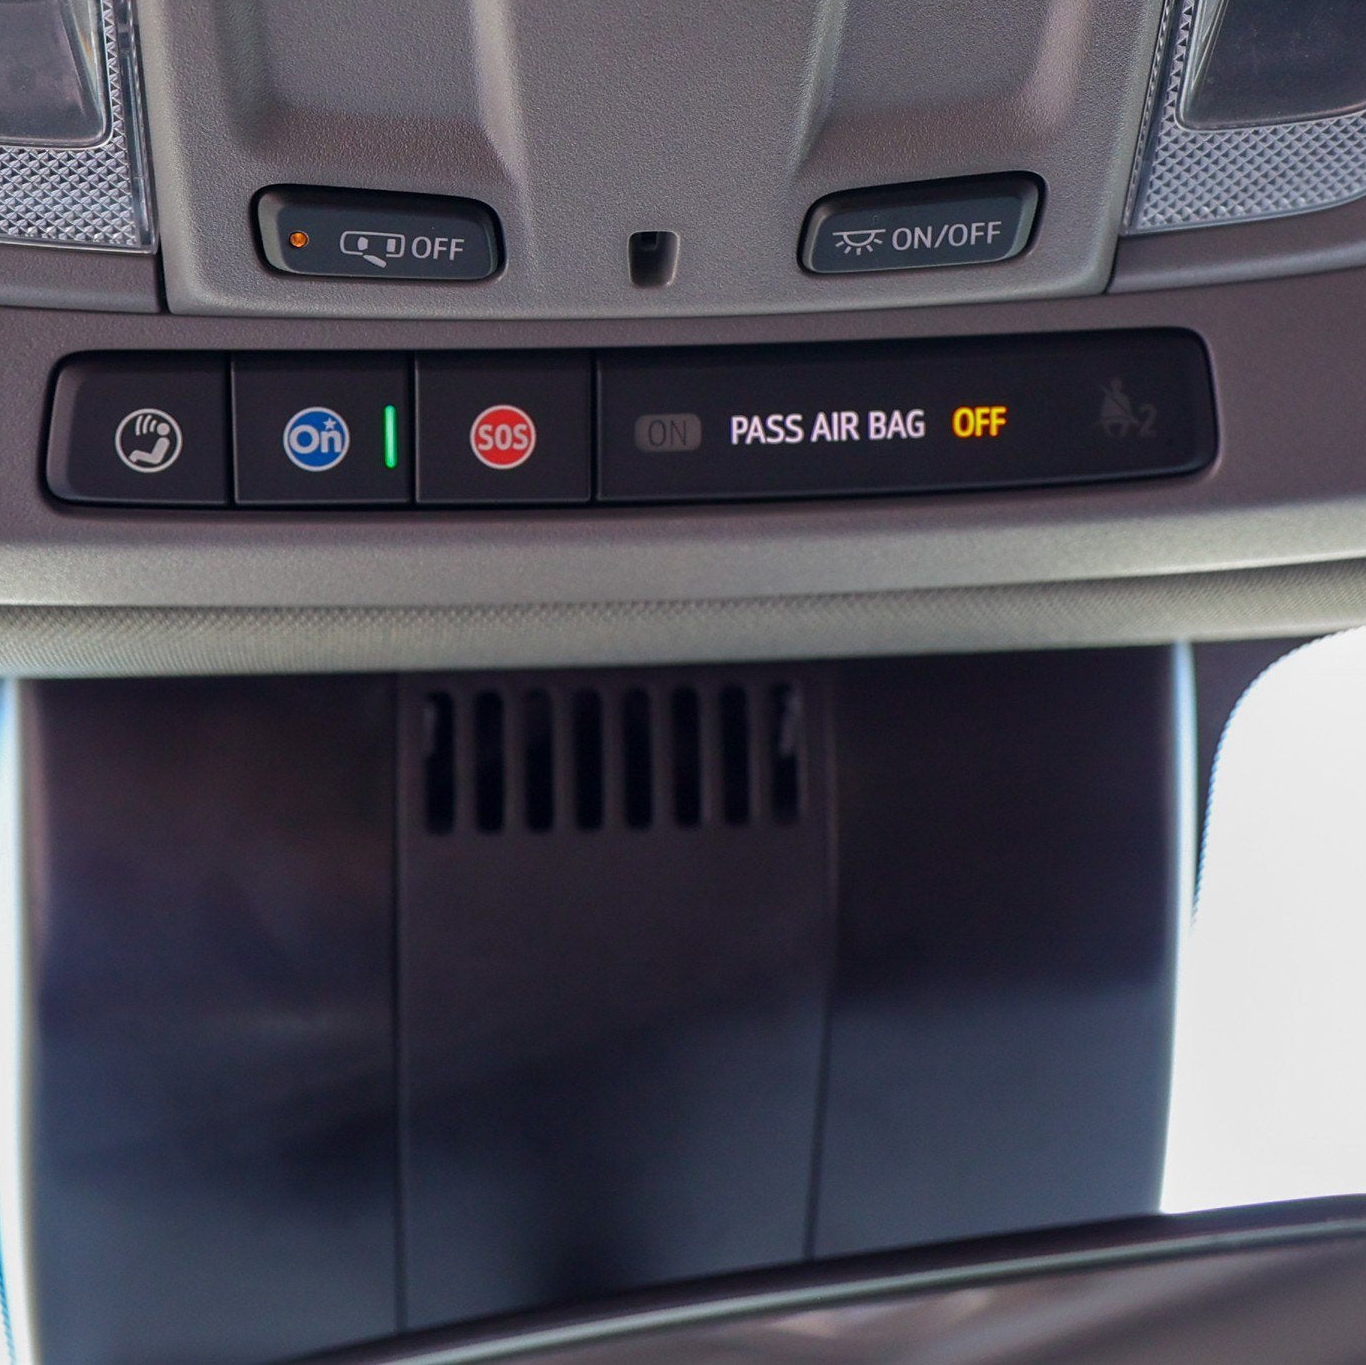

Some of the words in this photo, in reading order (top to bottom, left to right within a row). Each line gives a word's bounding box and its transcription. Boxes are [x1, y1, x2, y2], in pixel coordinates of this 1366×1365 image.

[411, 236, 465, 261] OFF
[891, 221, 1002, 251] ON/OFF
[289, 424, 342, 455] On
[478, 423, 529, 451] SOS
[647, 419, 687, 447] ON
[730, 413, 805, 445] PASS
[810, 410, 860, 443] AIR
[867, 408, 926, 440] BAG
[952, 406, 1008, 439] OFF
